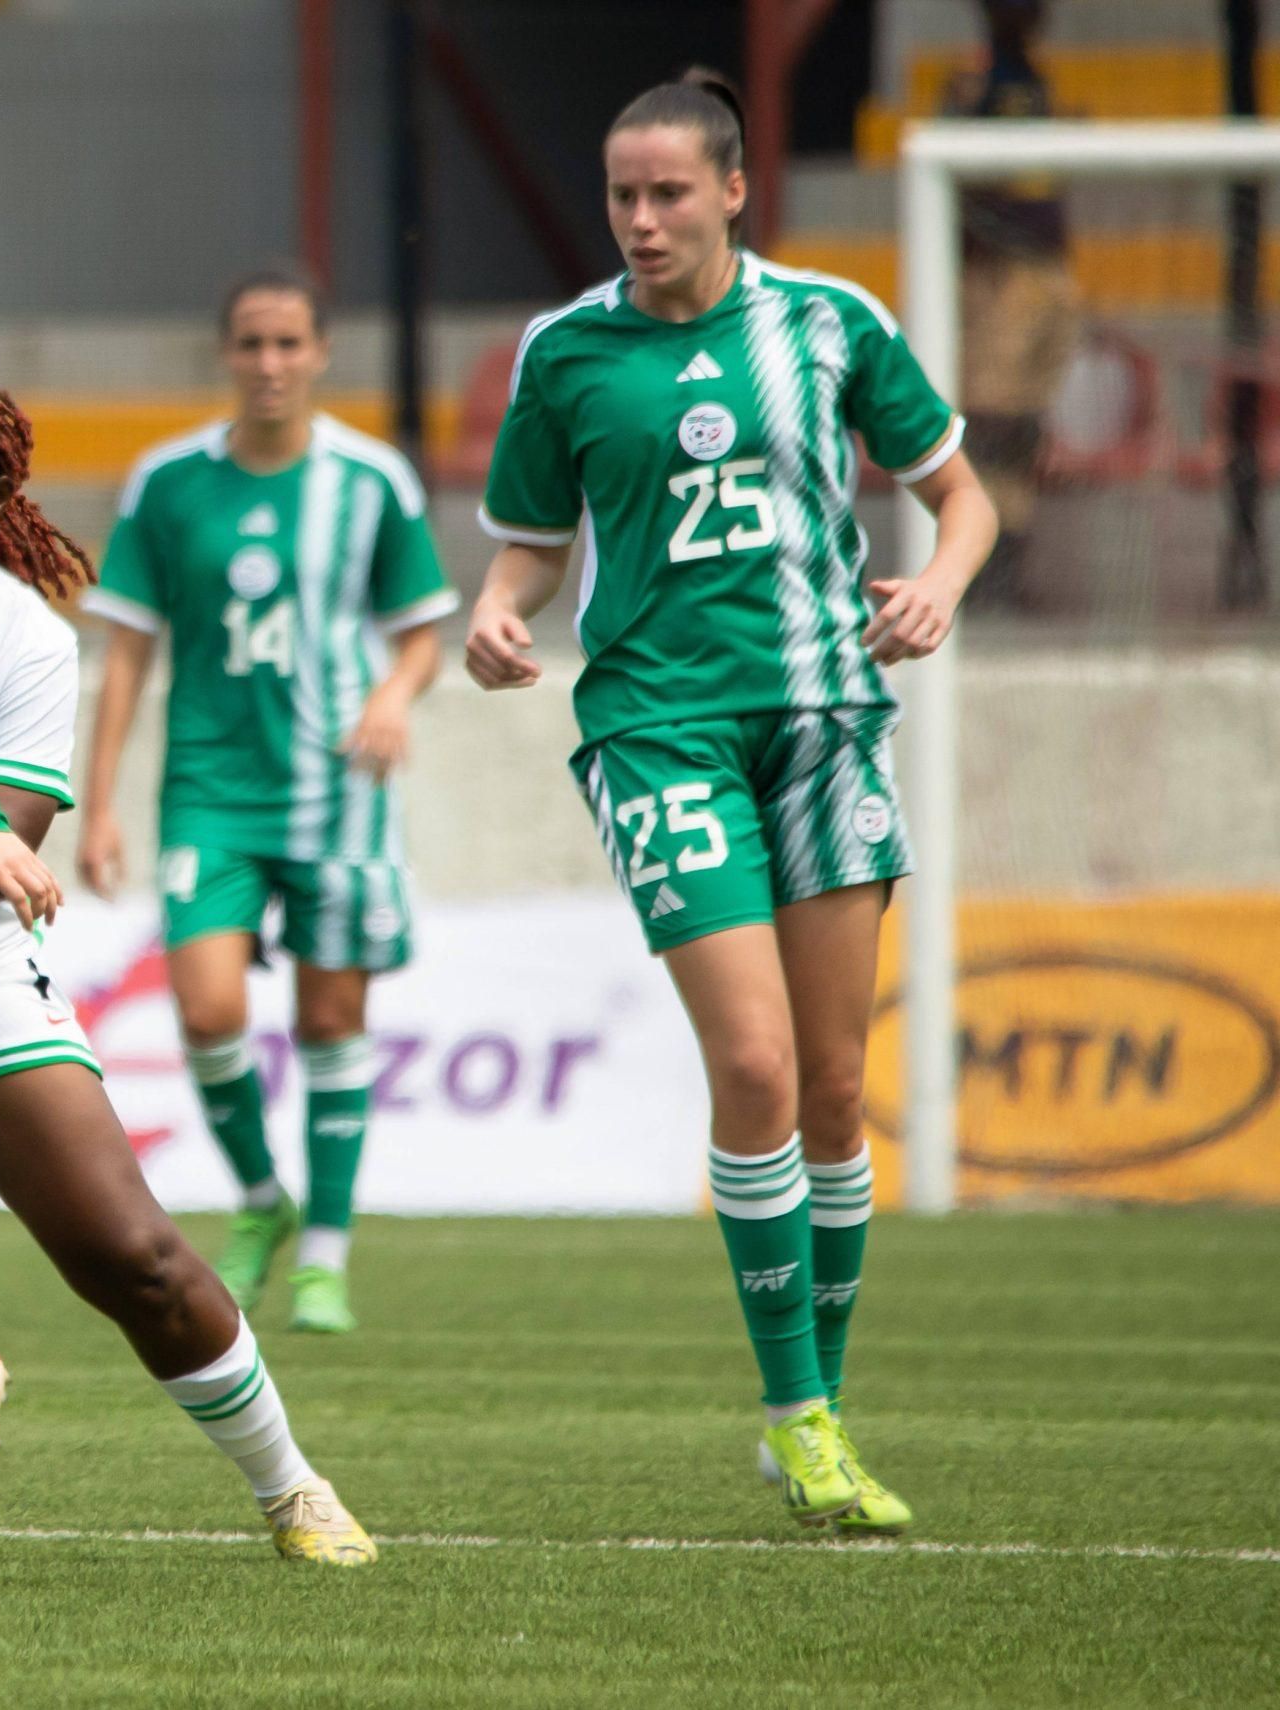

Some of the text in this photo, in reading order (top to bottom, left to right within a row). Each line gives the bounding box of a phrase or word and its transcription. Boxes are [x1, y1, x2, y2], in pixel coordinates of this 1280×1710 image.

[667, 458, 777, 563] 25
[221, 599, 293, 676] 14
[615, 782, 728, 888] 25
